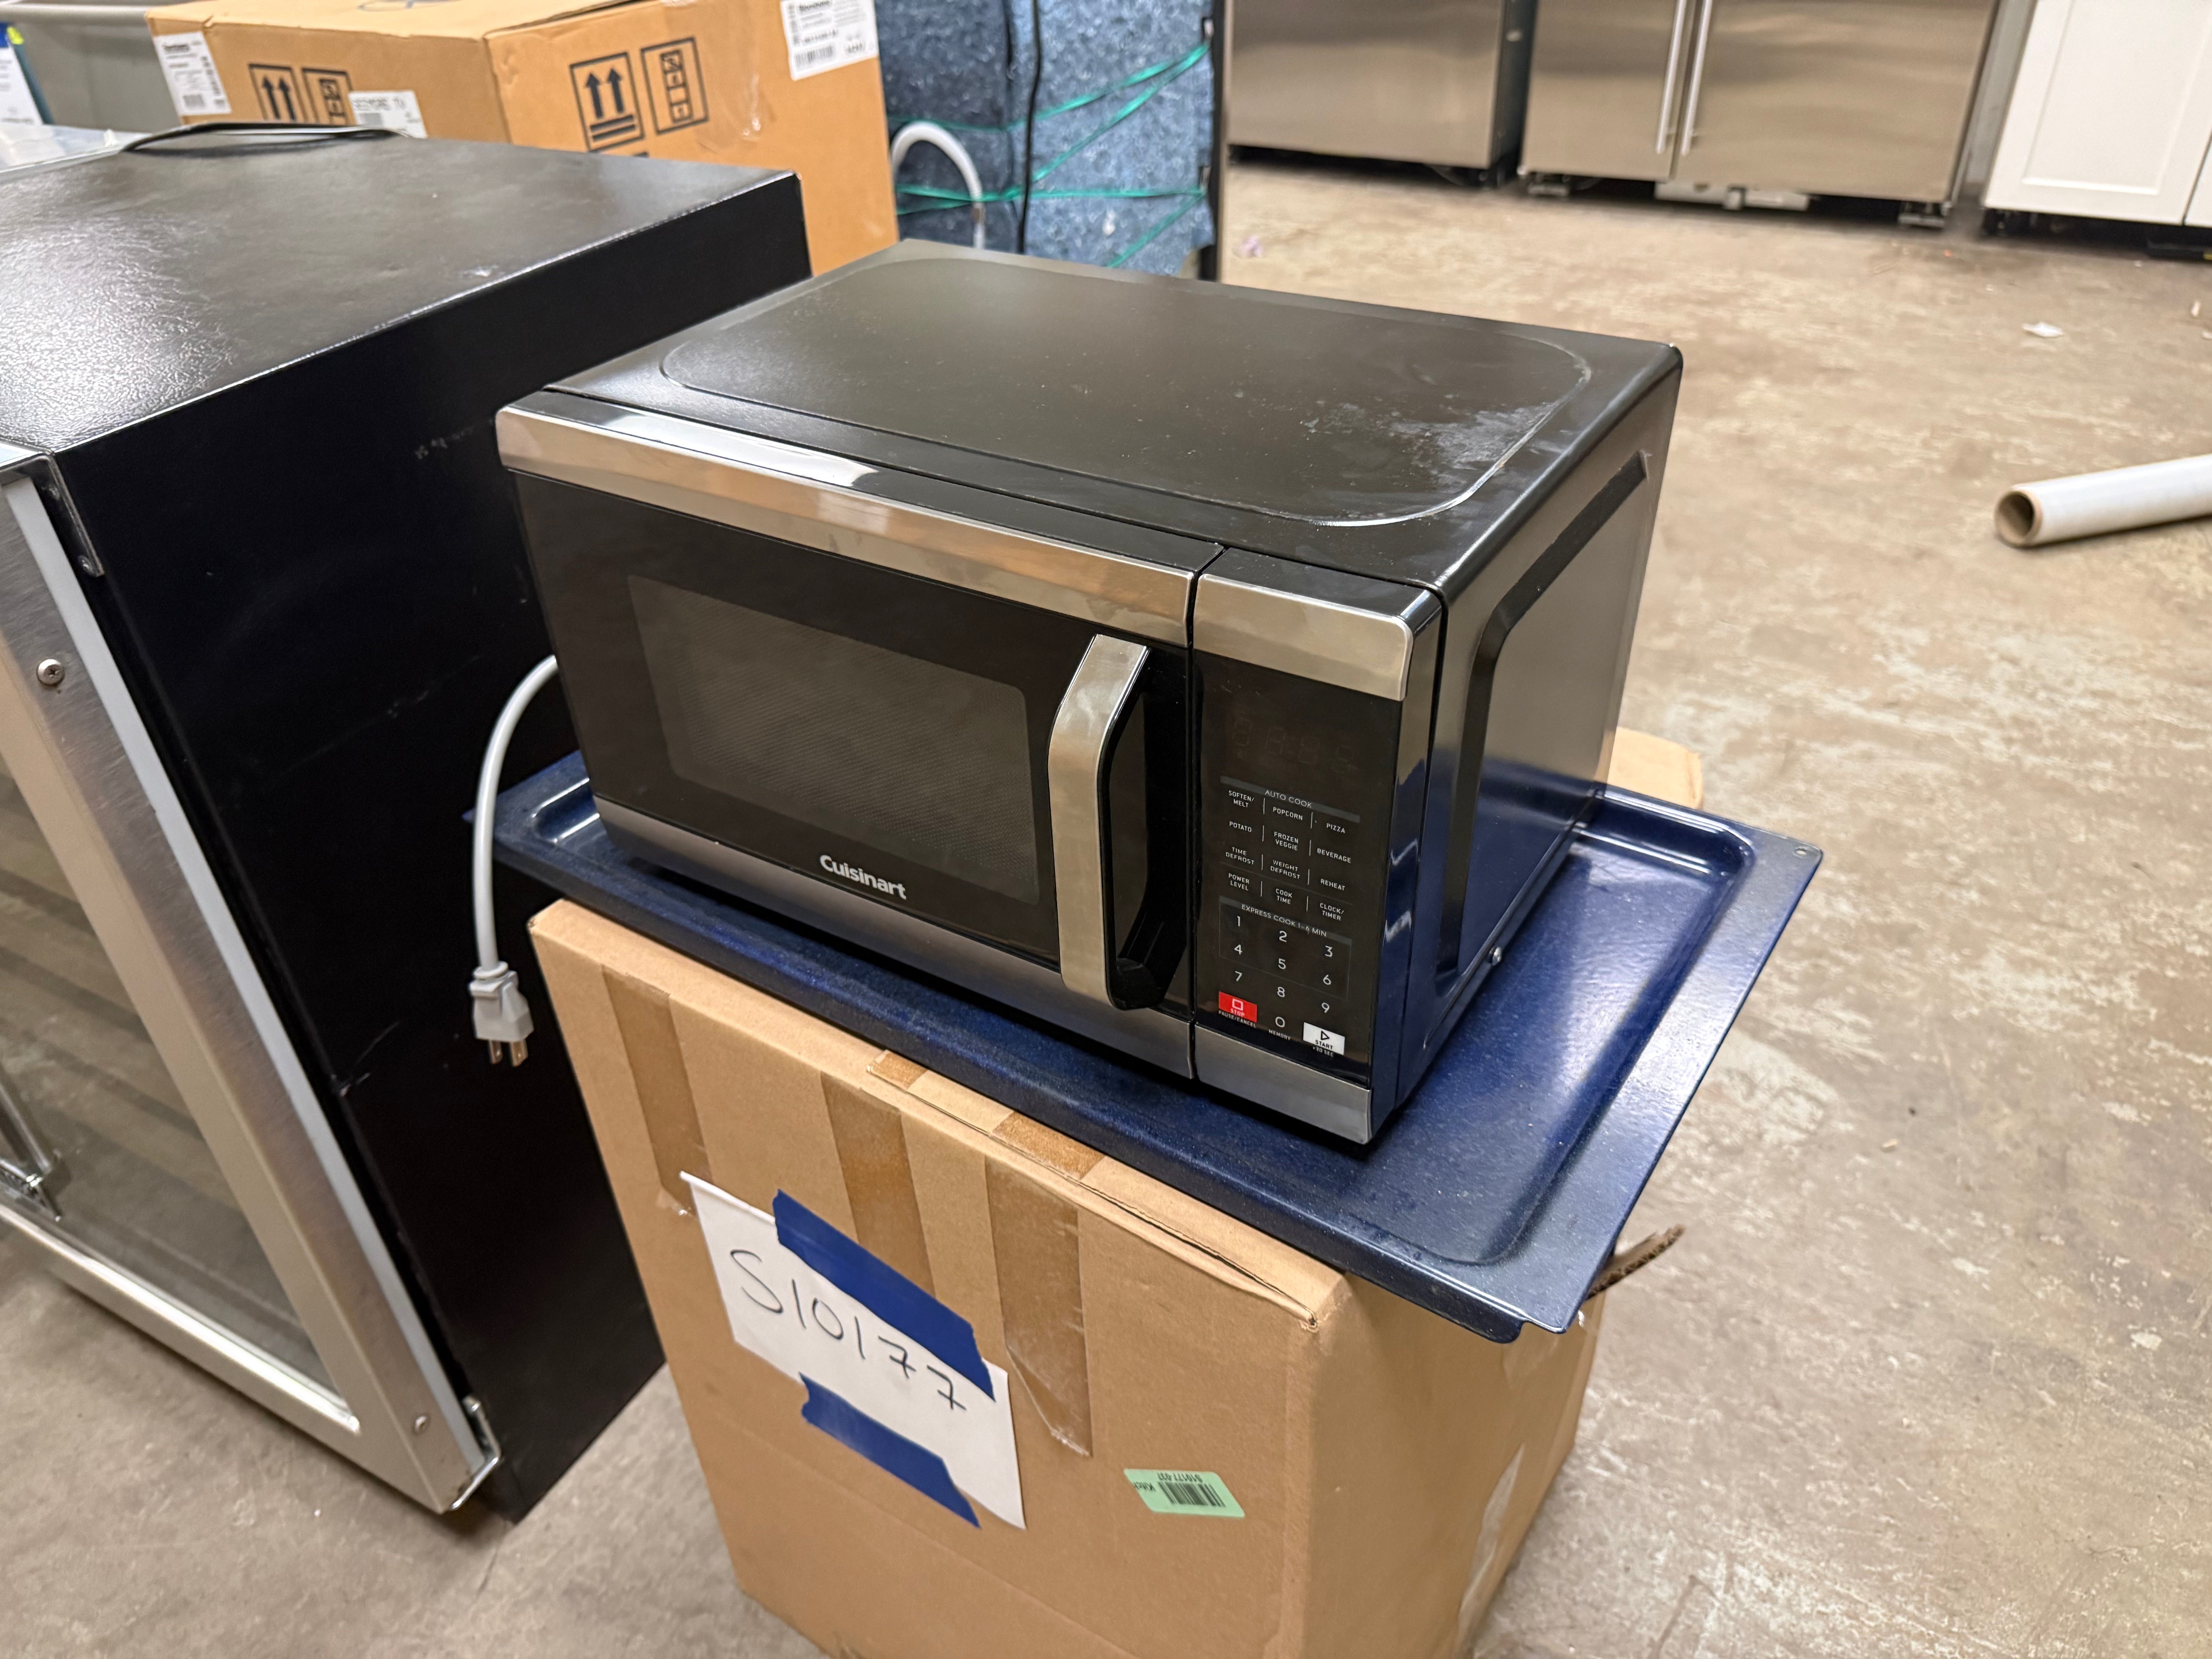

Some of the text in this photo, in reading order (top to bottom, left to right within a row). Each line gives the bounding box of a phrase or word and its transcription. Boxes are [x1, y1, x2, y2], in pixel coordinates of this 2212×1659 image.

[1228, 790, 1254, 802] SOFTEN/
[1265, 790, 1312, 808] AUTO COOK
[1233, 799, 1249, 808] MELT
[1273, 807, 1303, 821] POPCORN
[1229, 821, 1252, 832] POTATO
[1326, 823, 1345, 833] PIZZA
[1274, 831, 1298, 844] FROZEN
[1275, 839, 1298, 851] VEGGIE
[1232, 847, 1247, 856] TIME
[1317, 848, 1351, 863] BEVERAGE
[1225, 852, 1254, 865] DEFROST
[1273, 859, 1298, 872] WEIGHT
[819, 854, 907, 900] Cuisinart
[1270, 866, 1300, 879] DEFROST
[1228, 873, 1250, 884] POWER
[1230, 881, 1249, 891] LEVEL
[1321, 879, 1345, 891] REHEAT
[1276, 888, 1292, 898] COOK
[1277, 895, 1291, 905] TIME
[1320, 903, 1344, 914] CLOCK/
[1242, 903, 1271, 919] EXPRESS
[1273, 915, 1295, 927] COOK
[1312, 928, 1327, 937] MIN
[1322, 910, 1341, 921] TIMER
[1237, 916, 1240, 927] 1
[1279, 931, 1287, 942] 2
[1234, 944, 1243, 955] 4
[1325, 946, 1333, 958] 3
[1278, 958, 1286, 970] 5
[1235, 971, 1242, 981] 7
[1323, 974, 1331, 985] 6
[1277, 987, 1285, 998] 8
[1230, 1008, 1245, 1017] STOP
[1321, 1002, 1329, 1013] 9
[1218, 1010, 1257, 1028] PAUSE/CANCEL
[1269, 1029, 1291, 1041] MEMORY
[1315, 1039, 1333, 1050] START
[1324, 1049, 1334, 1058] SEC
[730, 1249, 967, 1411] S10177
